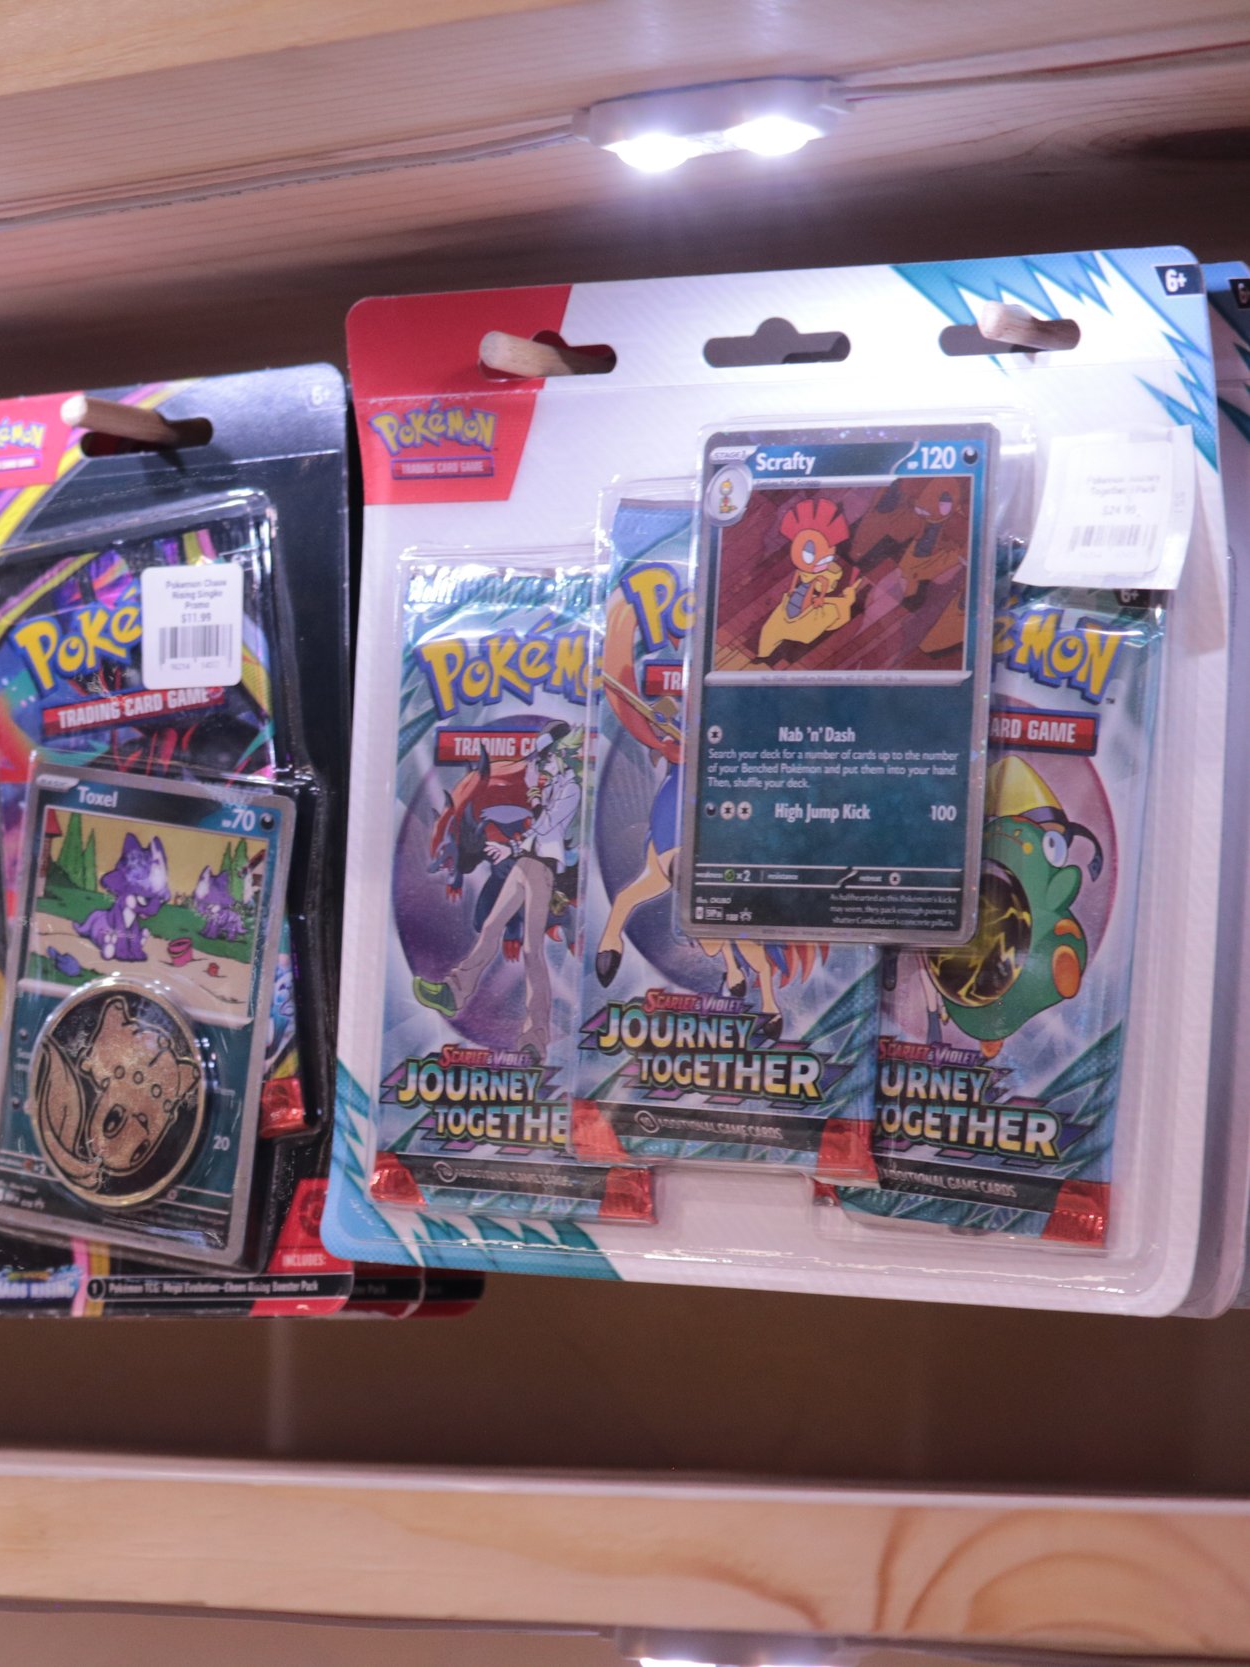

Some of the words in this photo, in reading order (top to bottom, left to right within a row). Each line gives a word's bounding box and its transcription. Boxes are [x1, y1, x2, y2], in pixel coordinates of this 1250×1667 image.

[1165, 268, 1188, 293] 6+
[755, 451, 816, 475] Scrafty
[921, 446, 956, 470] 120
[12, 586, 143, 690] Poké
[58, 703, 122, 729] TRADING
[124, 694, 164, 717] CARD
[167, 688, 210, 710] GAME
[778, 727, 804, 743] Nab
[825, 727, 856, 743] Dash
[991, 718, 1022, 739] ARD
[1027, 720, 1077, 743] GAME
[707, 748, 737, 759] Search
[738, 751, 759, 762] your
[760, 749, 781, 759] deck
[782, 749, 796, 759] for
[797, 751, 804, 759] a
[804, 749, 839, 760] number
[840, 749, 852, 760] of
[852, 750, 877, 760] cards
[878, 752, 891, 763] up
[892, 751, 904, 760] to
[904, 750, 921, 760] the
[922, 750, 959, 761] number
[707, 762, 718, 773] of
[719, 765, 739, 776] your
[741, 762, 779, 774] Benched
[824, 764, 841, 774] and
[842, 765, 859, 777] put
[860, 764, 885, 775] them
[887, 764, 907, 775] into
[907, 767, 930, 778] your
[932, 764, 958, 776] hand.
[733, 777, 763, 789] shuffle
[763, 780, 785, 791] your
[77, 785, 117, 808] Toxel
[231, 808, 256, 832] 70
[775, 803, 803, 823] High
[805, 803, 840, 823] Jump
[843, 804, 871, 820] Kick
[930, 805, 957, 821] 100
[599, 1007, 751, 1049] JOURNEY
[398, 1062, 540, 1102] JOURNEY
[636, 1053, 821, 1098] TOGETHER
[880, 1063, 987, 1104] URNEY
[434, 1105, 568, 1144] TOGETHE
[213, 1135, 230, 1150] 20
